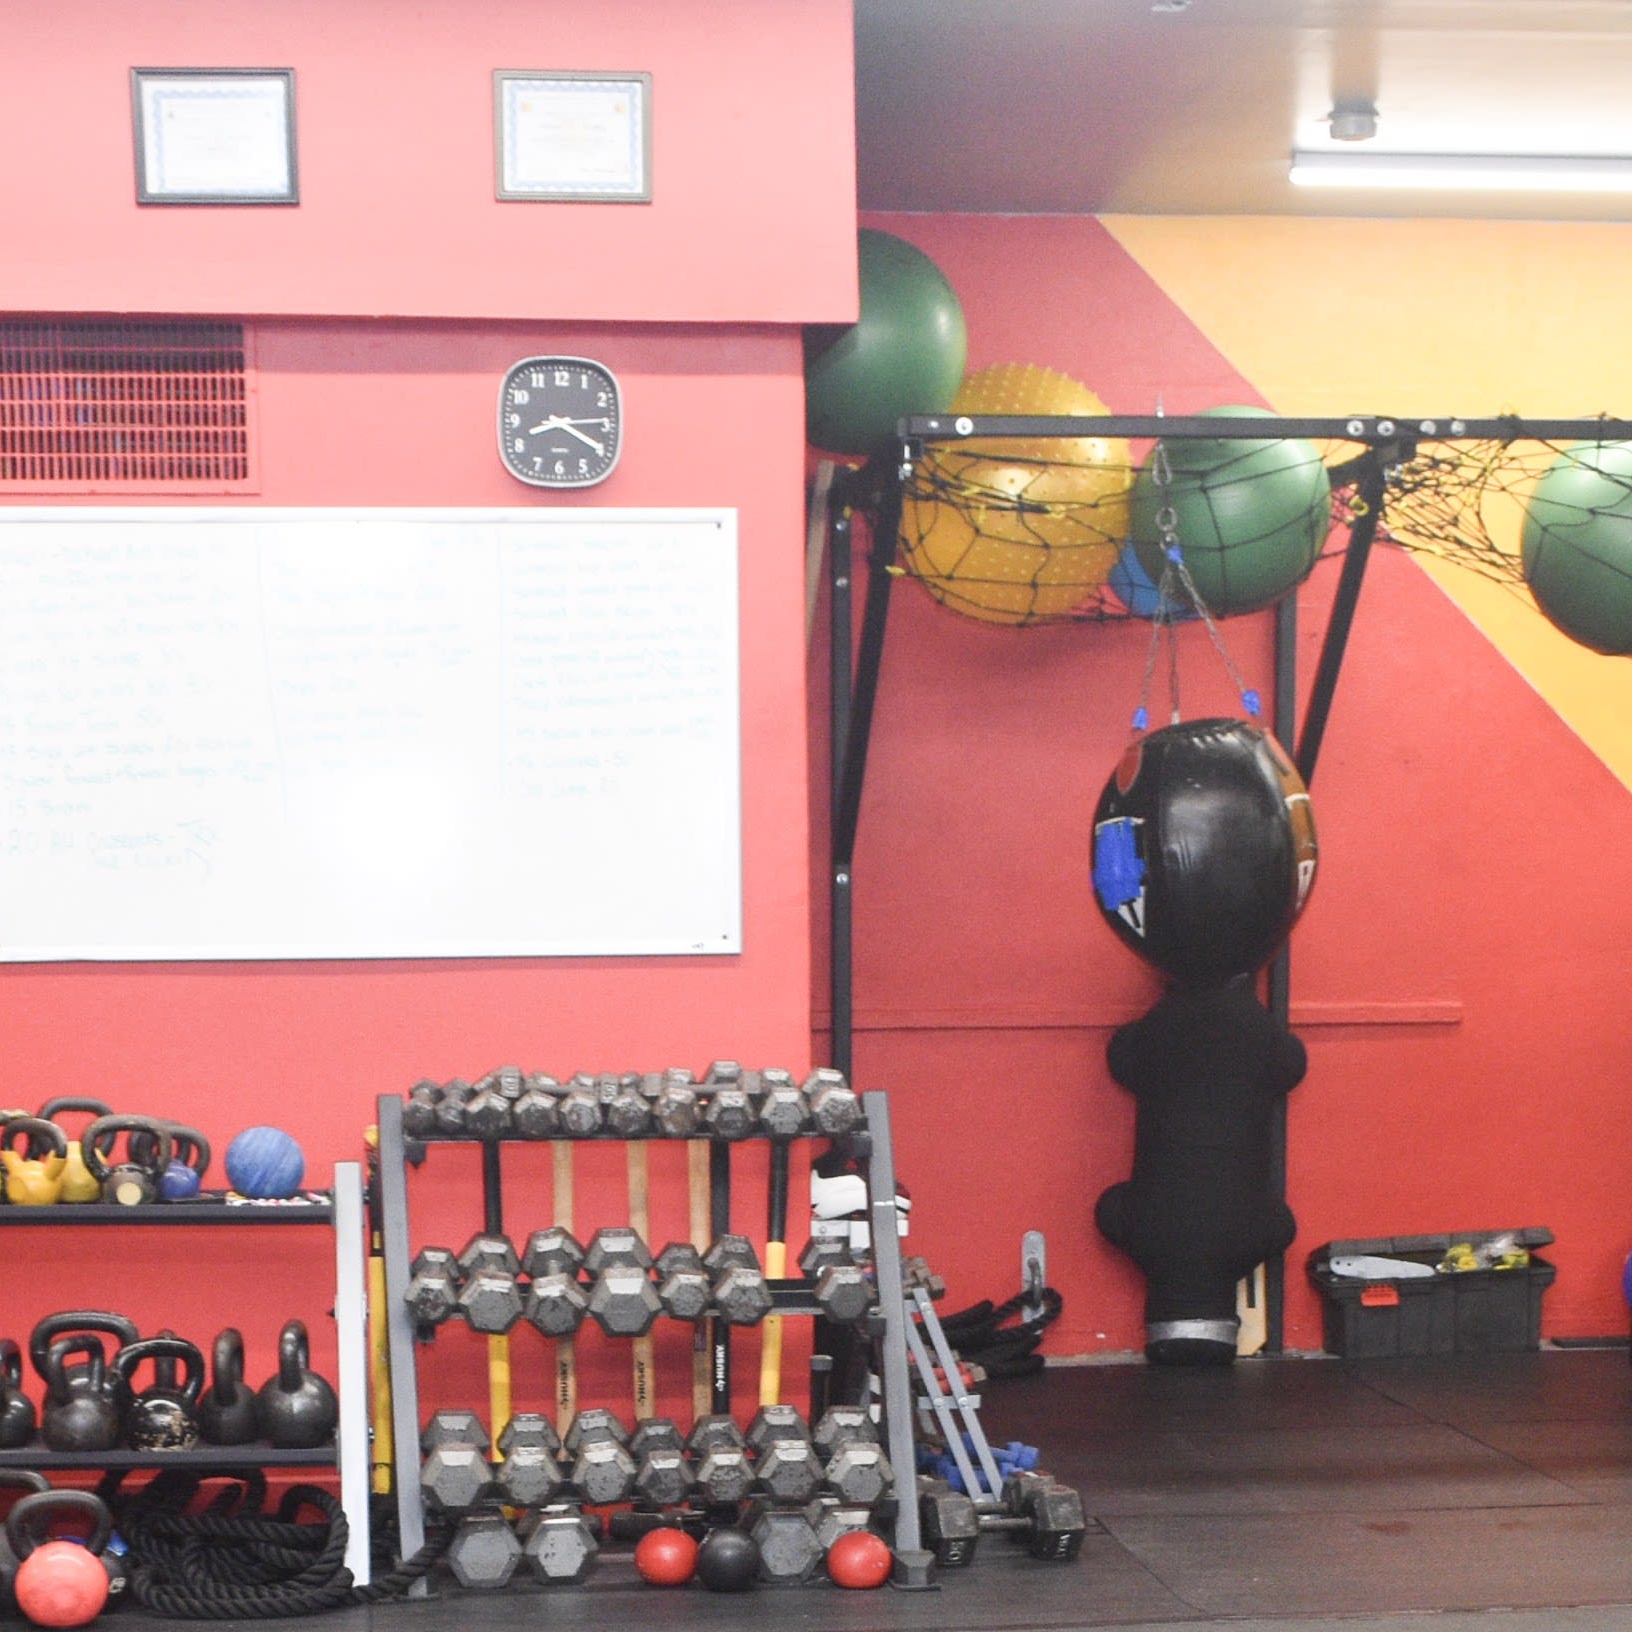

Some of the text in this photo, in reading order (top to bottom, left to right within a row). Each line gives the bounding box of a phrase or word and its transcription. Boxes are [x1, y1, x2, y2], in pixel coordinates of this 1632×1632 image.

[531, 372, 545, 388] 11
[554, 371, 570, 387] 12
[580, 374, 588, 389] 1
[513, 389, 529, 405] 10
[597, 392, 608, 408] 2
[510, 413, 521, 428] 9
[600, 417, 610, 432] 3
[514, 438, 525, 453] 8
[532, 456, 543, 471] 7
[554, 460, 565, 474] 6
[578, 458, 588, 474] 5
[715, 1344, 725, 1379] HUSKY
[559, 1361, 569, 1397] HUSKY
[637, 1360, 647, 1396] HUSKY
